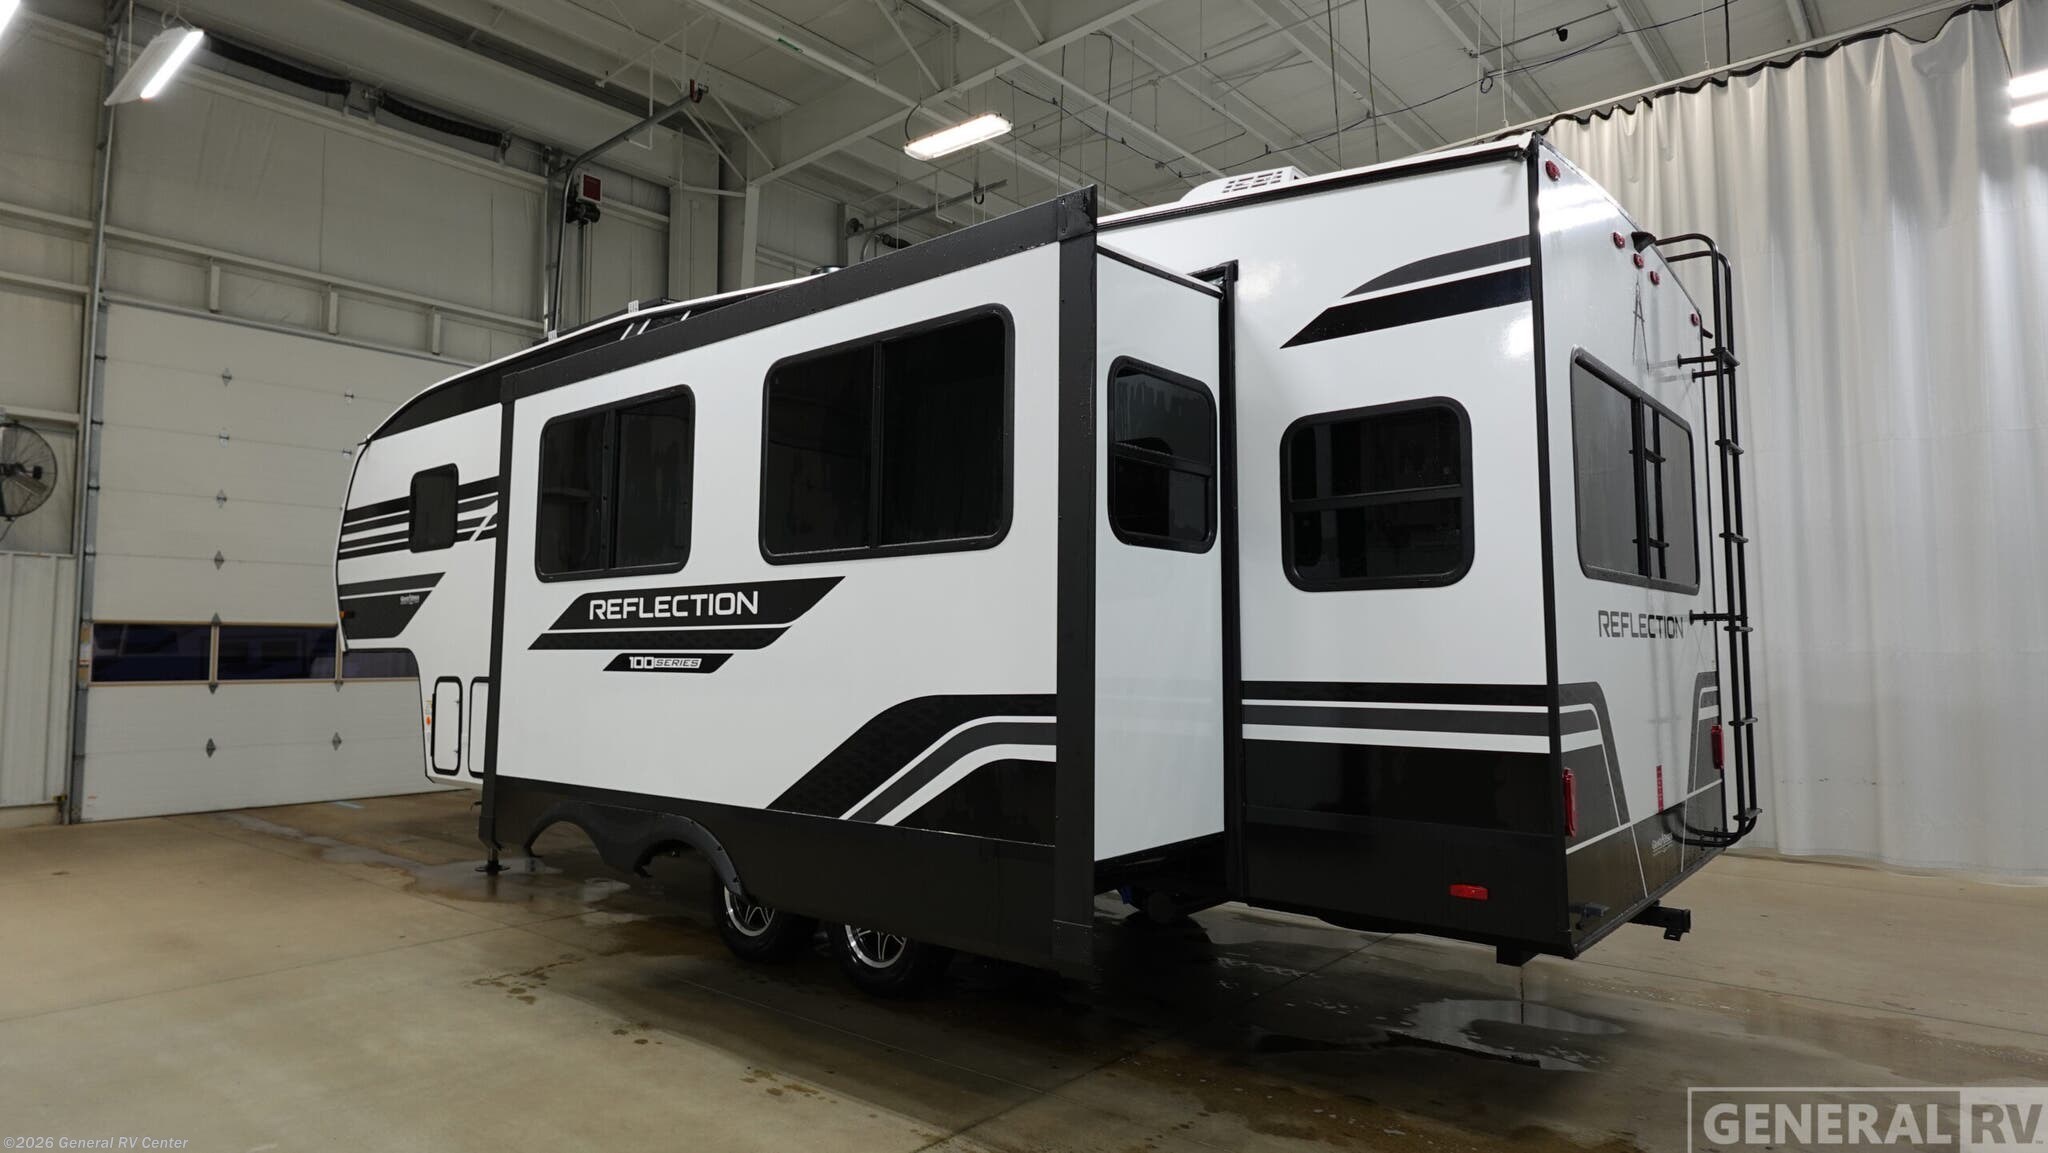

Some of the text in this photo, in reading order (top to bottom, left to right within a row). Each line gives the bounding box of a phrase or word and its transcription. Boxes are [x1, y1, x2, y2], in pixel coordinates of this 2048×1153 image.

[589, 590, 759, 621] REFLECTION
[1598, 610, 1684, 639] REFLECTION
[629, 656, 701, 670] 100 SERIES
